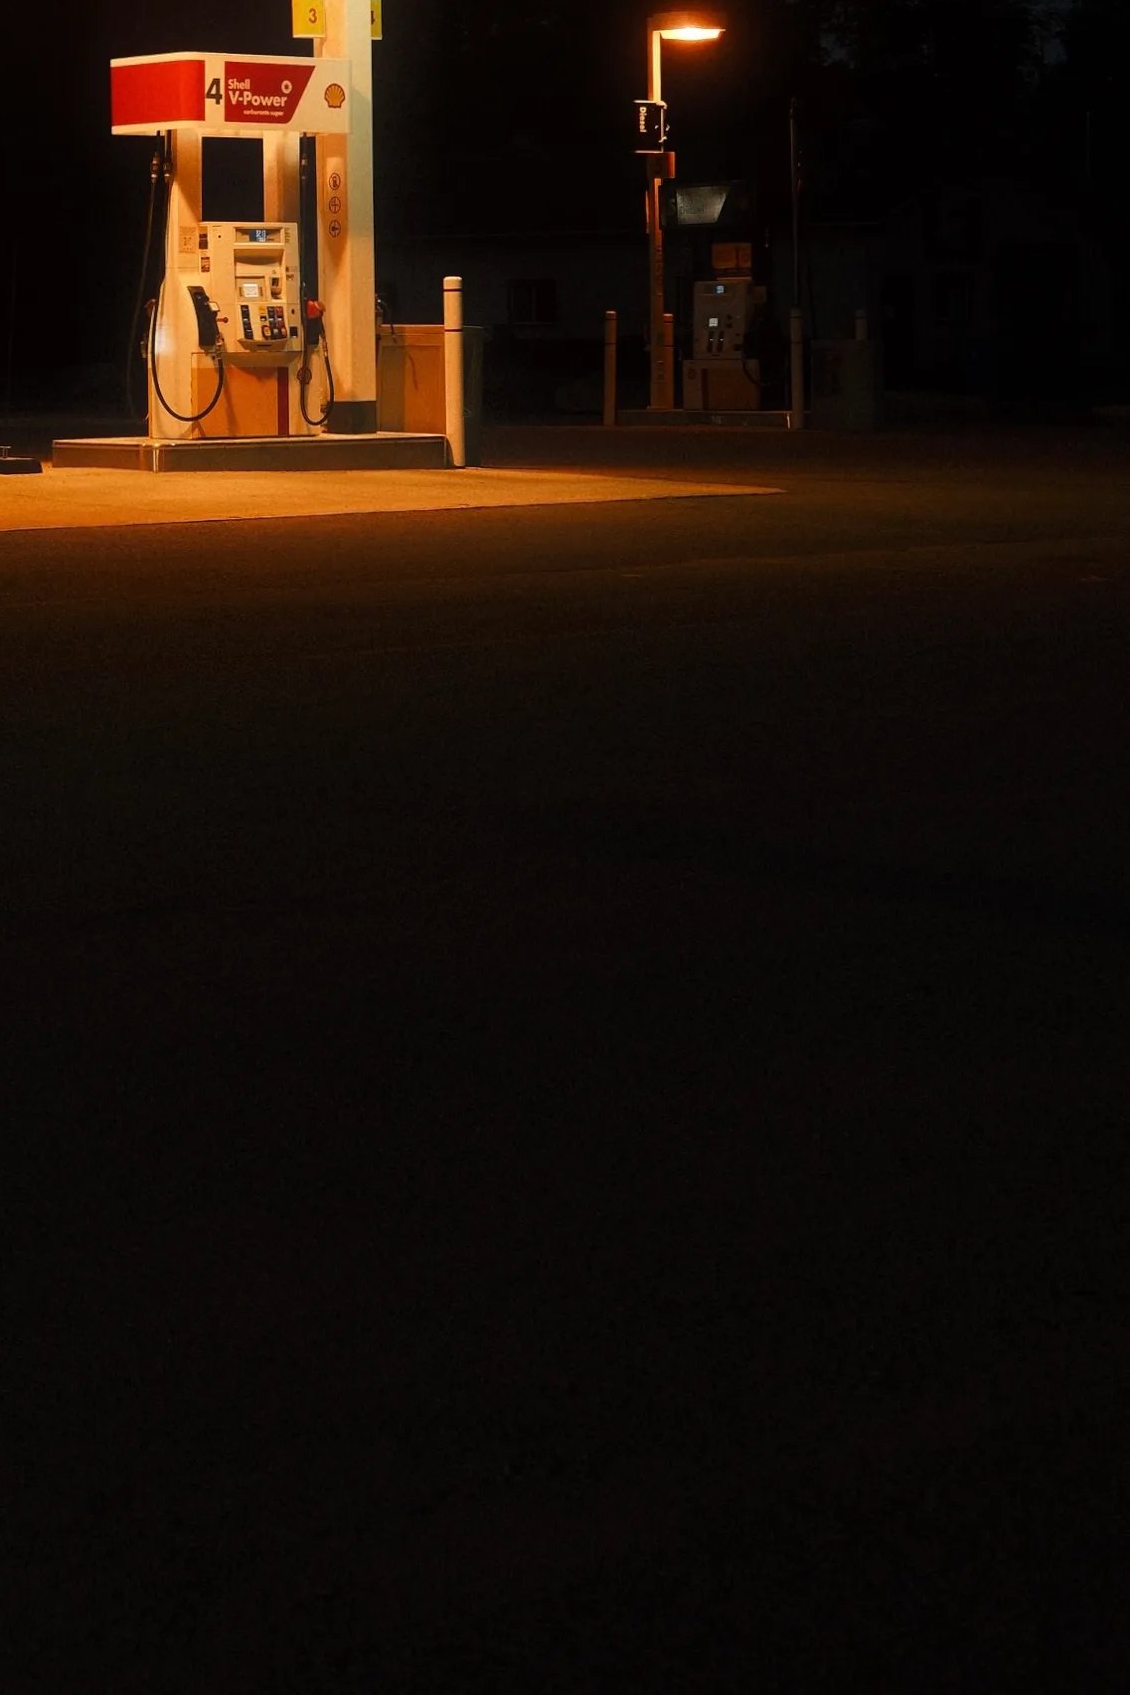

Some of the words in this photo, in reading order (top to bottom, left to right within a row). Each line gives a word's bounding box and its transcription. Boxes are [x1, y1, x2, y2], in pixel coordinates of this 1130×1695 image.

[308, 8, 318, 24] 3
[205, 78, 223, 105] 4
[227, 78, 251, 90] Shell
[228, 91, 288, 107] V-Power
[639, 106, 648, 133] Diesel
